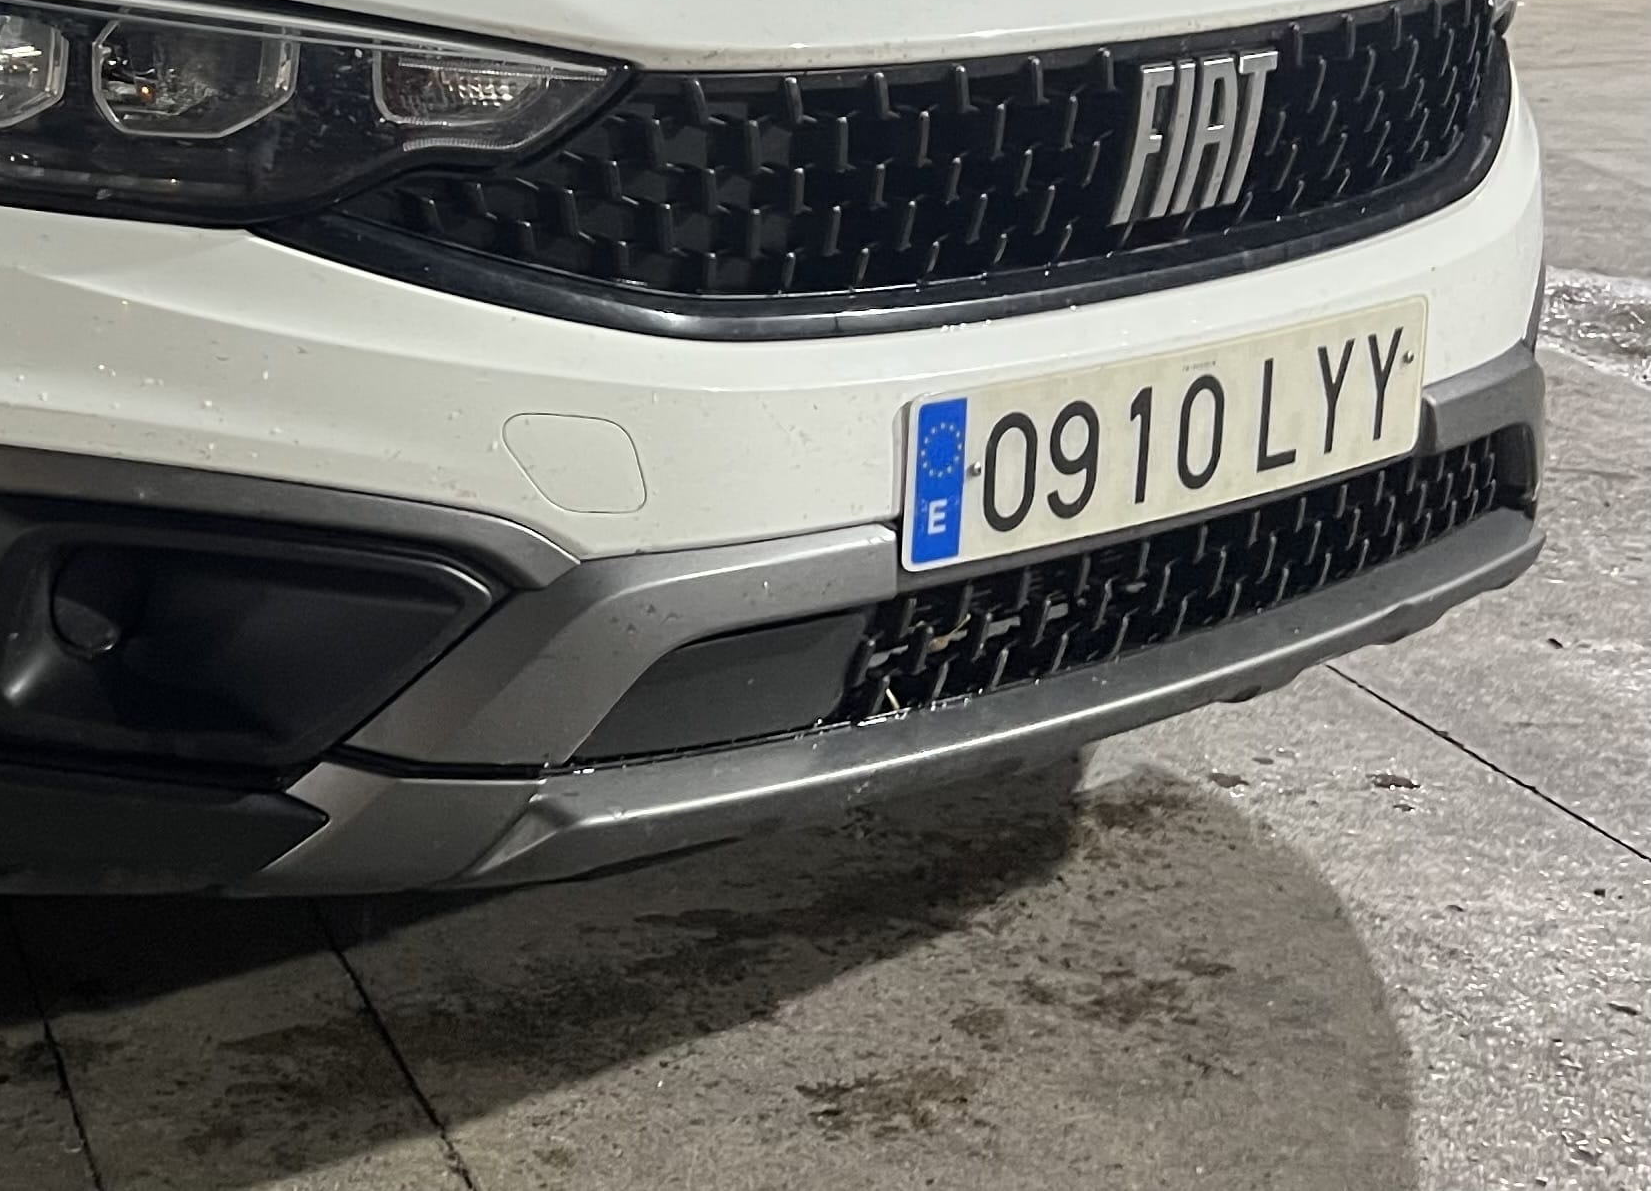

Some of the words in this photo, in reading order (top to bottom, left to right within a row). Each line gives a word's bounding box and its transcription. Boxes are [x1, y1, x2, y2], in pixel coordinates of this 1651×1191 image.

[1109, 50, 1278, 226] FIAT
[927, 498, 947, 535] E
[982, 374, 1225, 532] 0910
[1256, 326, 1404, 472] LYY
